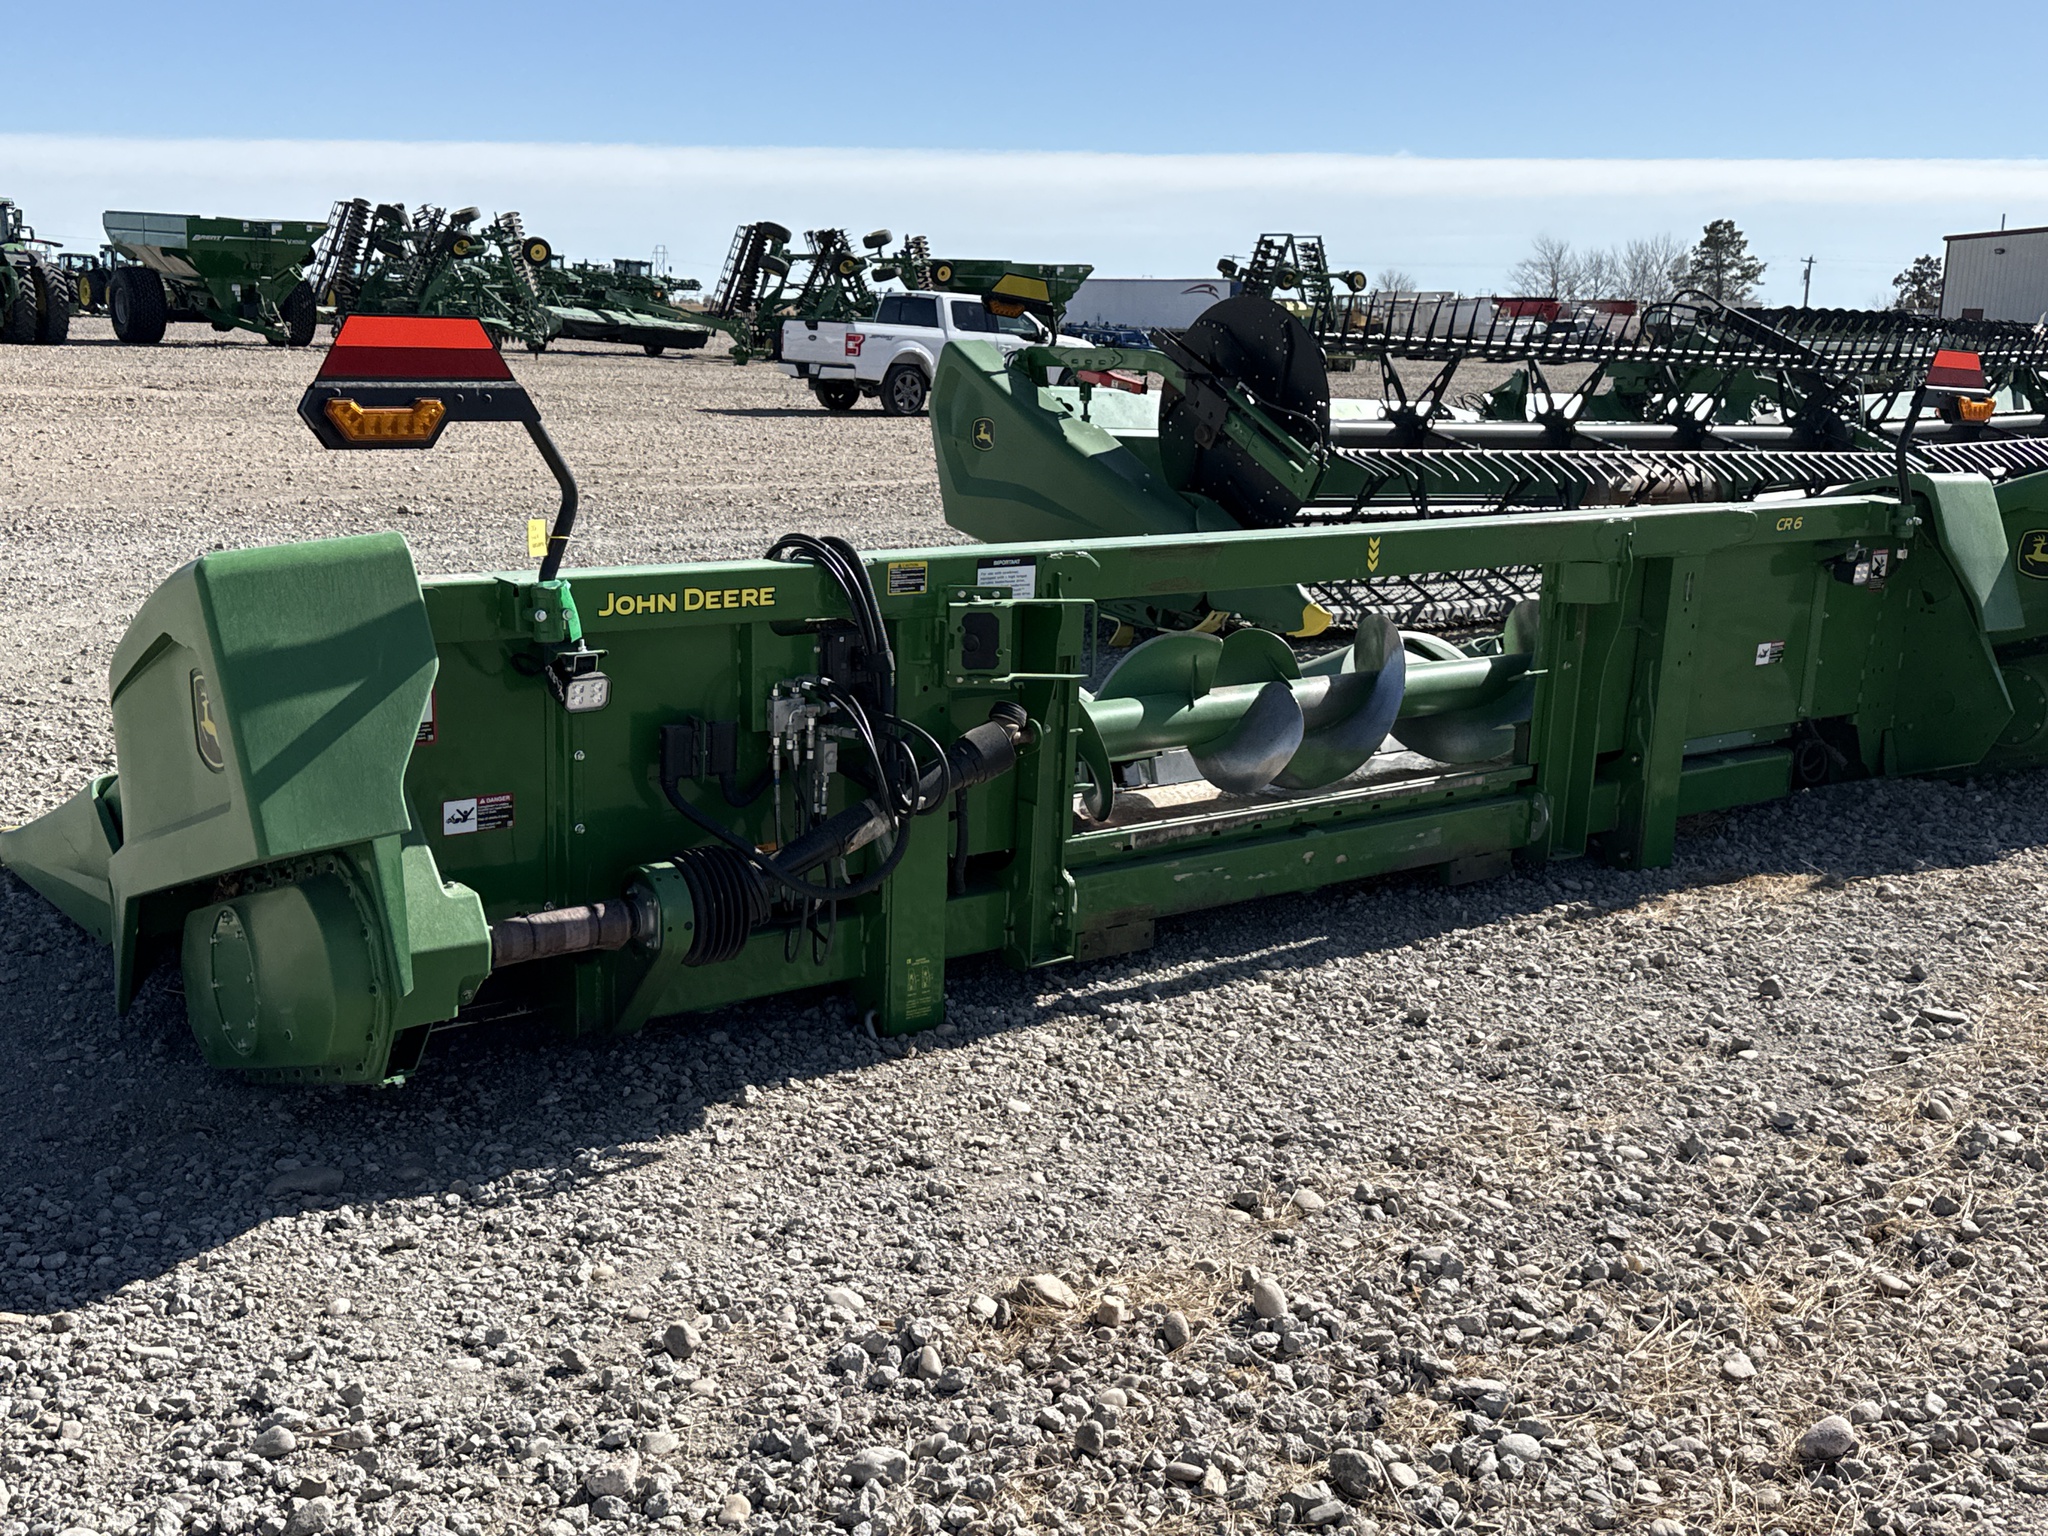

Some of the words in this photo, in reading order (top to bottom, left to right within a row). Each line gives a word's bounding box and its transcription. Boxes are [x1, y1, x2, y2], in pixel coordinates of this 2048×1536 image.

[1776, 517, 1793, 531] CR
[1794, 516, 1803, 530] 6
[598, 592, 676, 617] JOHN
[684, 587, 776, 611] DEERE
[486, 795, 511, 804] DANGER
